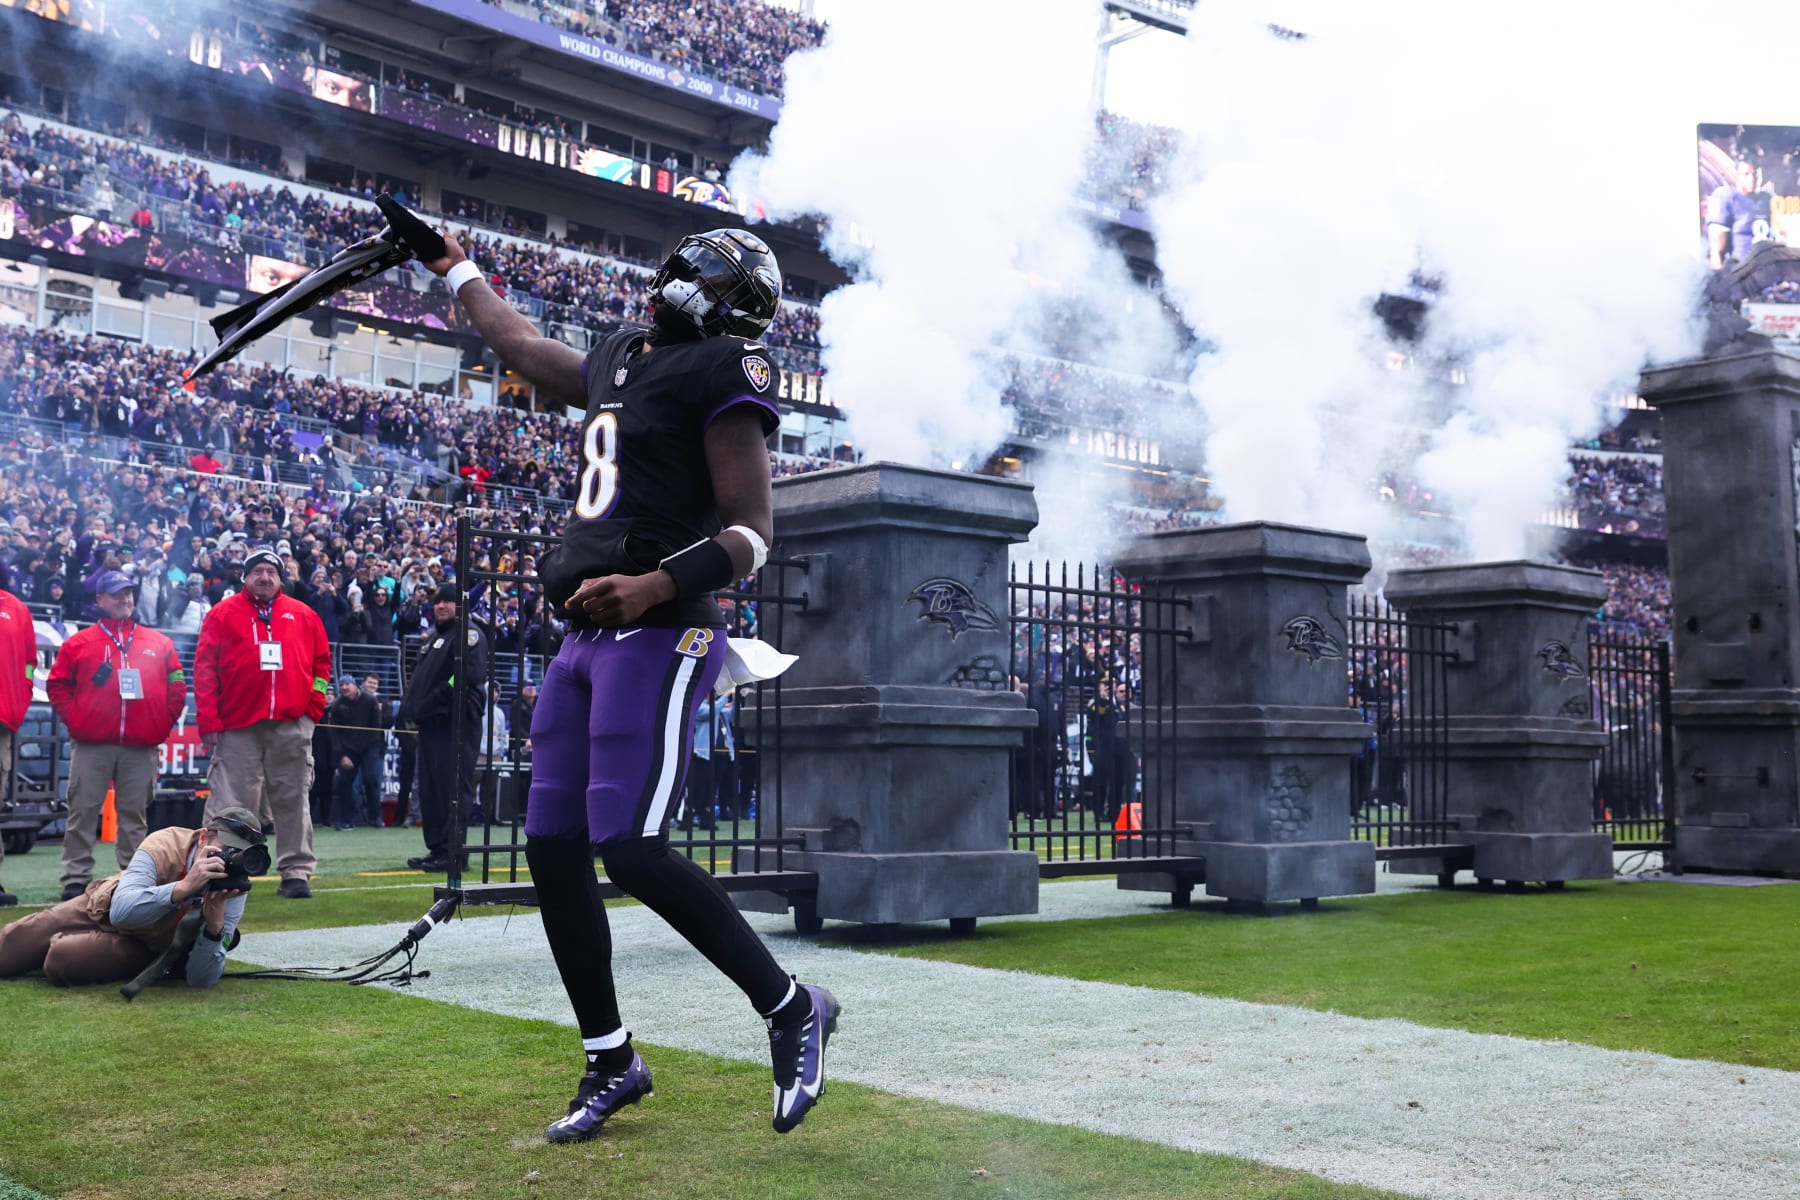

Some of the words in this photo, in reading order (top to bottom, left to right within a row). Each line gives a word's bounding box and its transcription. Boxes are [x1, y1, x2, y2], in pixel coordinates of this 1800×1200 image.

[560, 34, 600, 59] WORLD
[602, 49, 666, 80] CHAMPIONS
[687, 77, 713, 95] 2000
[734, 92, 759, 111] 2012
[575, 411, 621, 520] 8
[675, 628, 714, 657] B
